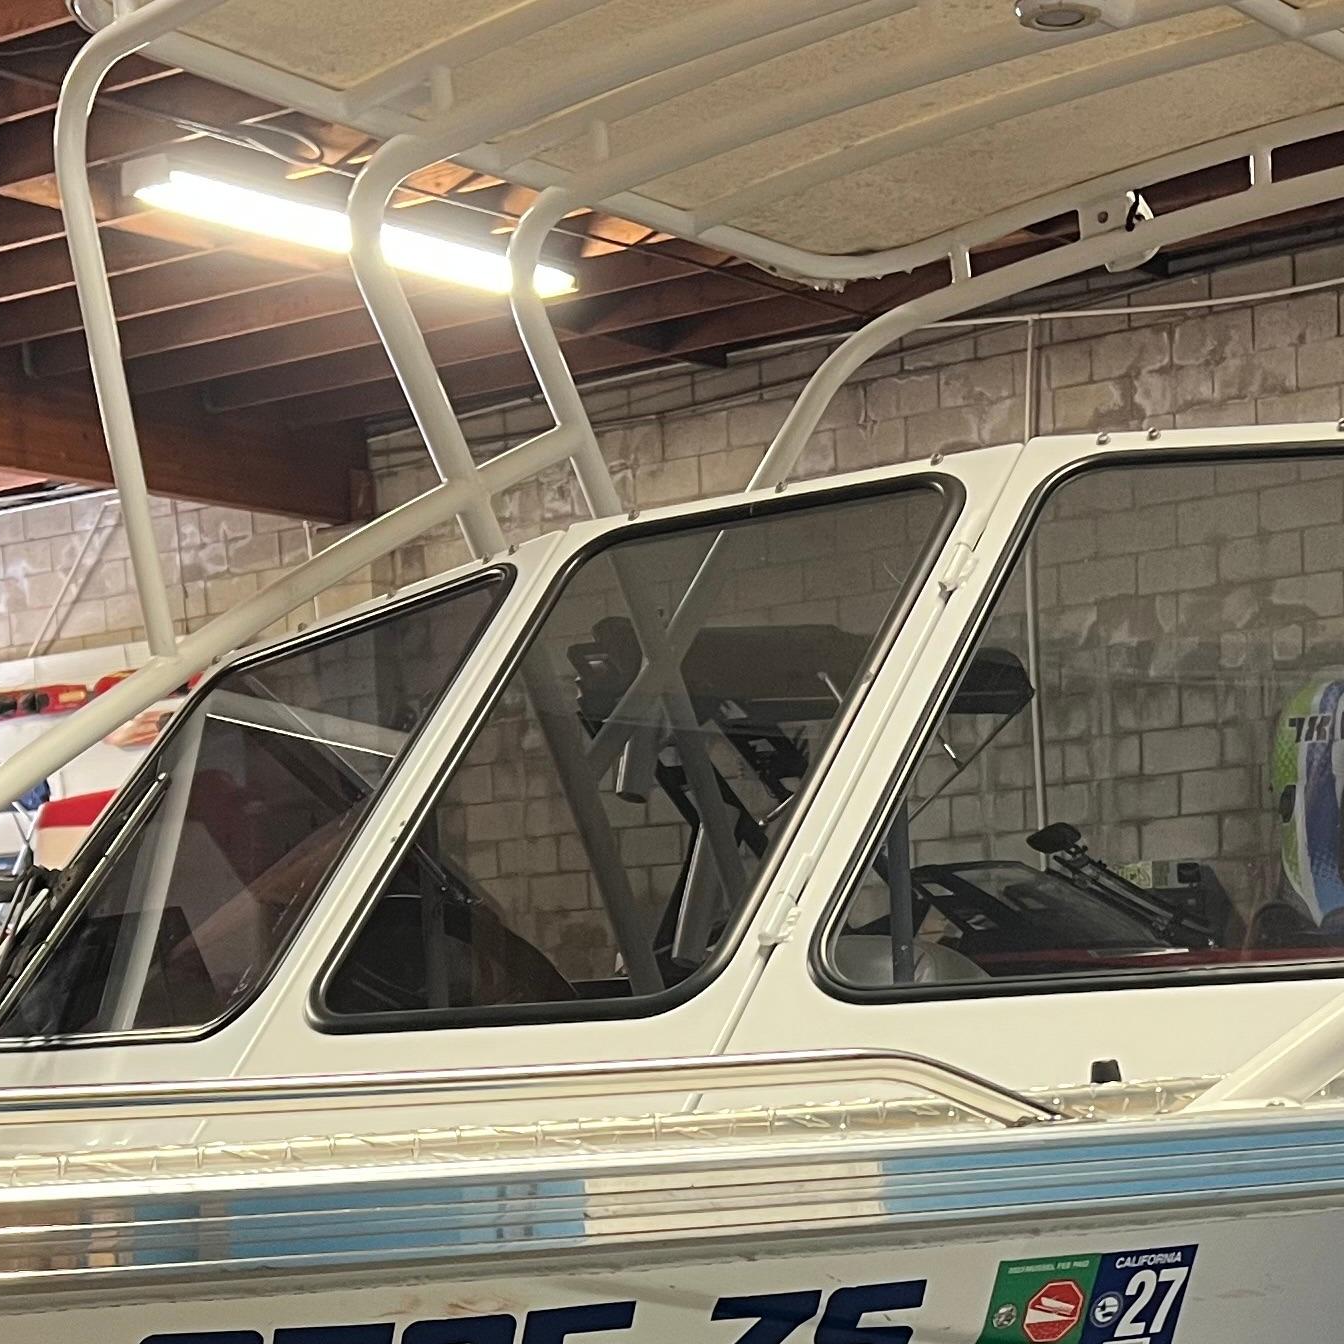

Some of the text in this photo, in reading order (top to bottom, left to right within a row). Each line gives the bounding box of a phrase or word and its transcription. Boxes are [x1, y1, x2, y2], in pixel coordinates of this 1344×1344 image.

[1288, 714, 1331, 743] XL
[1115, 1250, 1183, 1269] CALIFORNIA
[1113, 1266, 1189, 1338] 27
